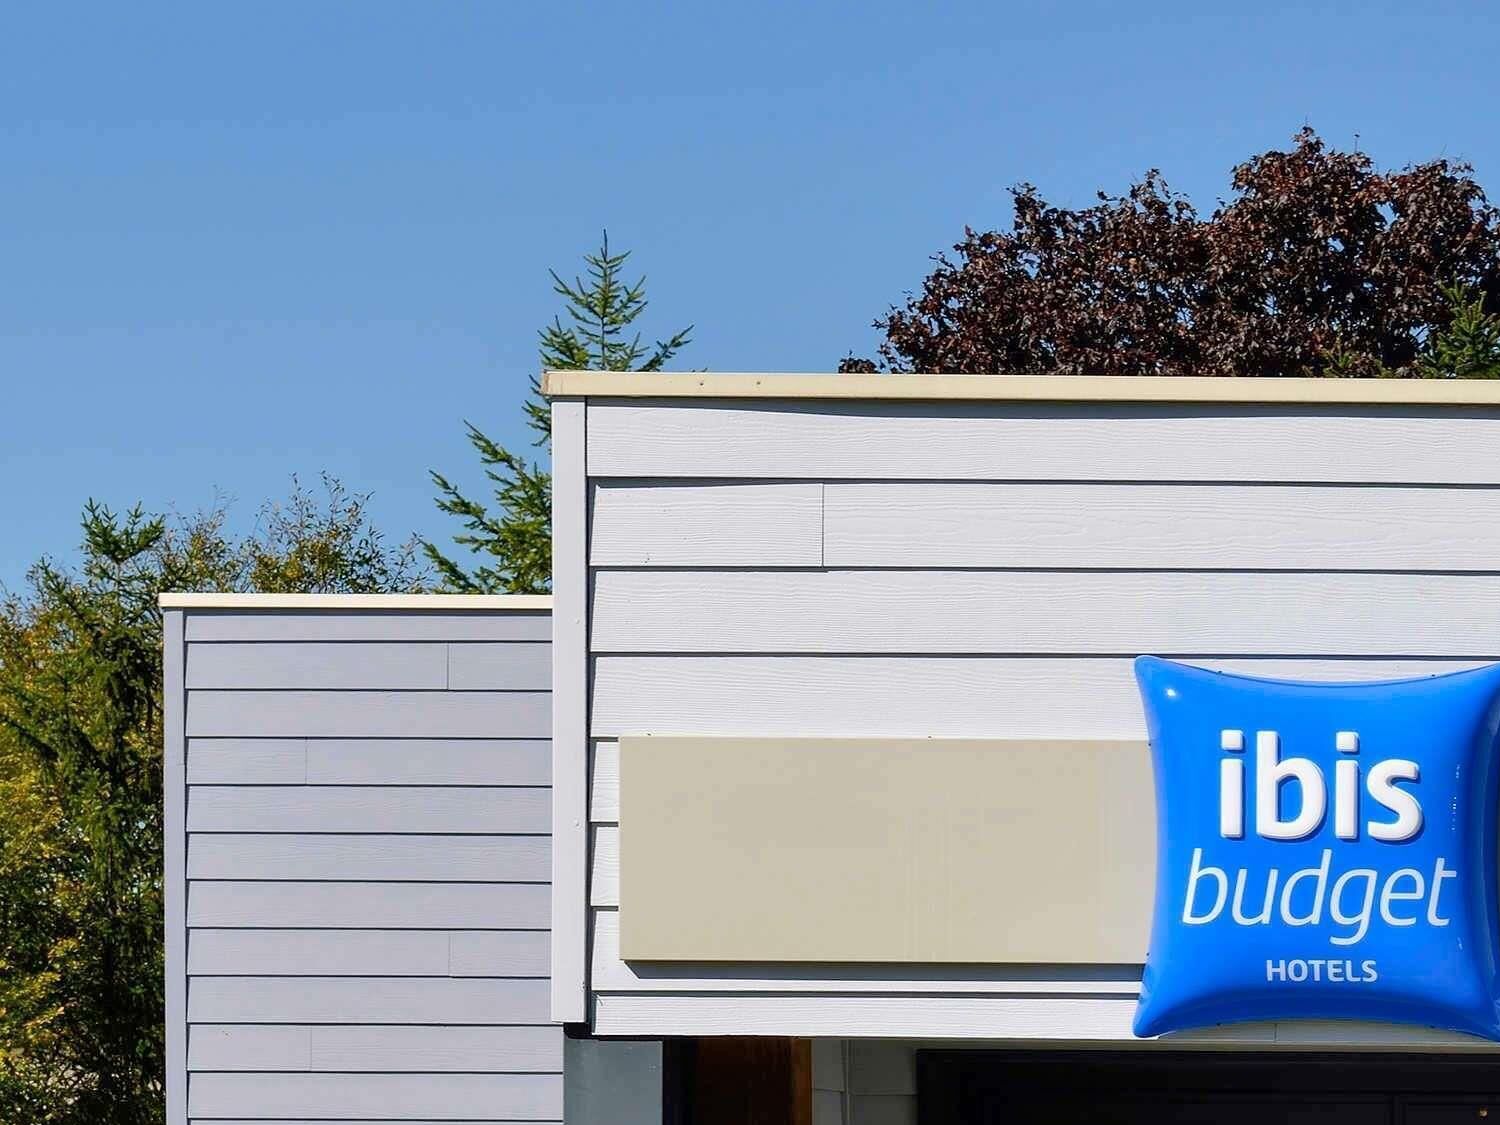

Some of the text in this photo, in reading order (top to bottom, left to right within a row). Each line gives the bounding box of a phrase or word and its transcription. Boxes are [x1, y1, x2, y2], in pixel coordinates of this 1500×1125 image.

[1219, 729, 1425, 842] ibis
[1180, 847, 1458, 947] budget
[1264, 958, 1379, 984] HOTELS
